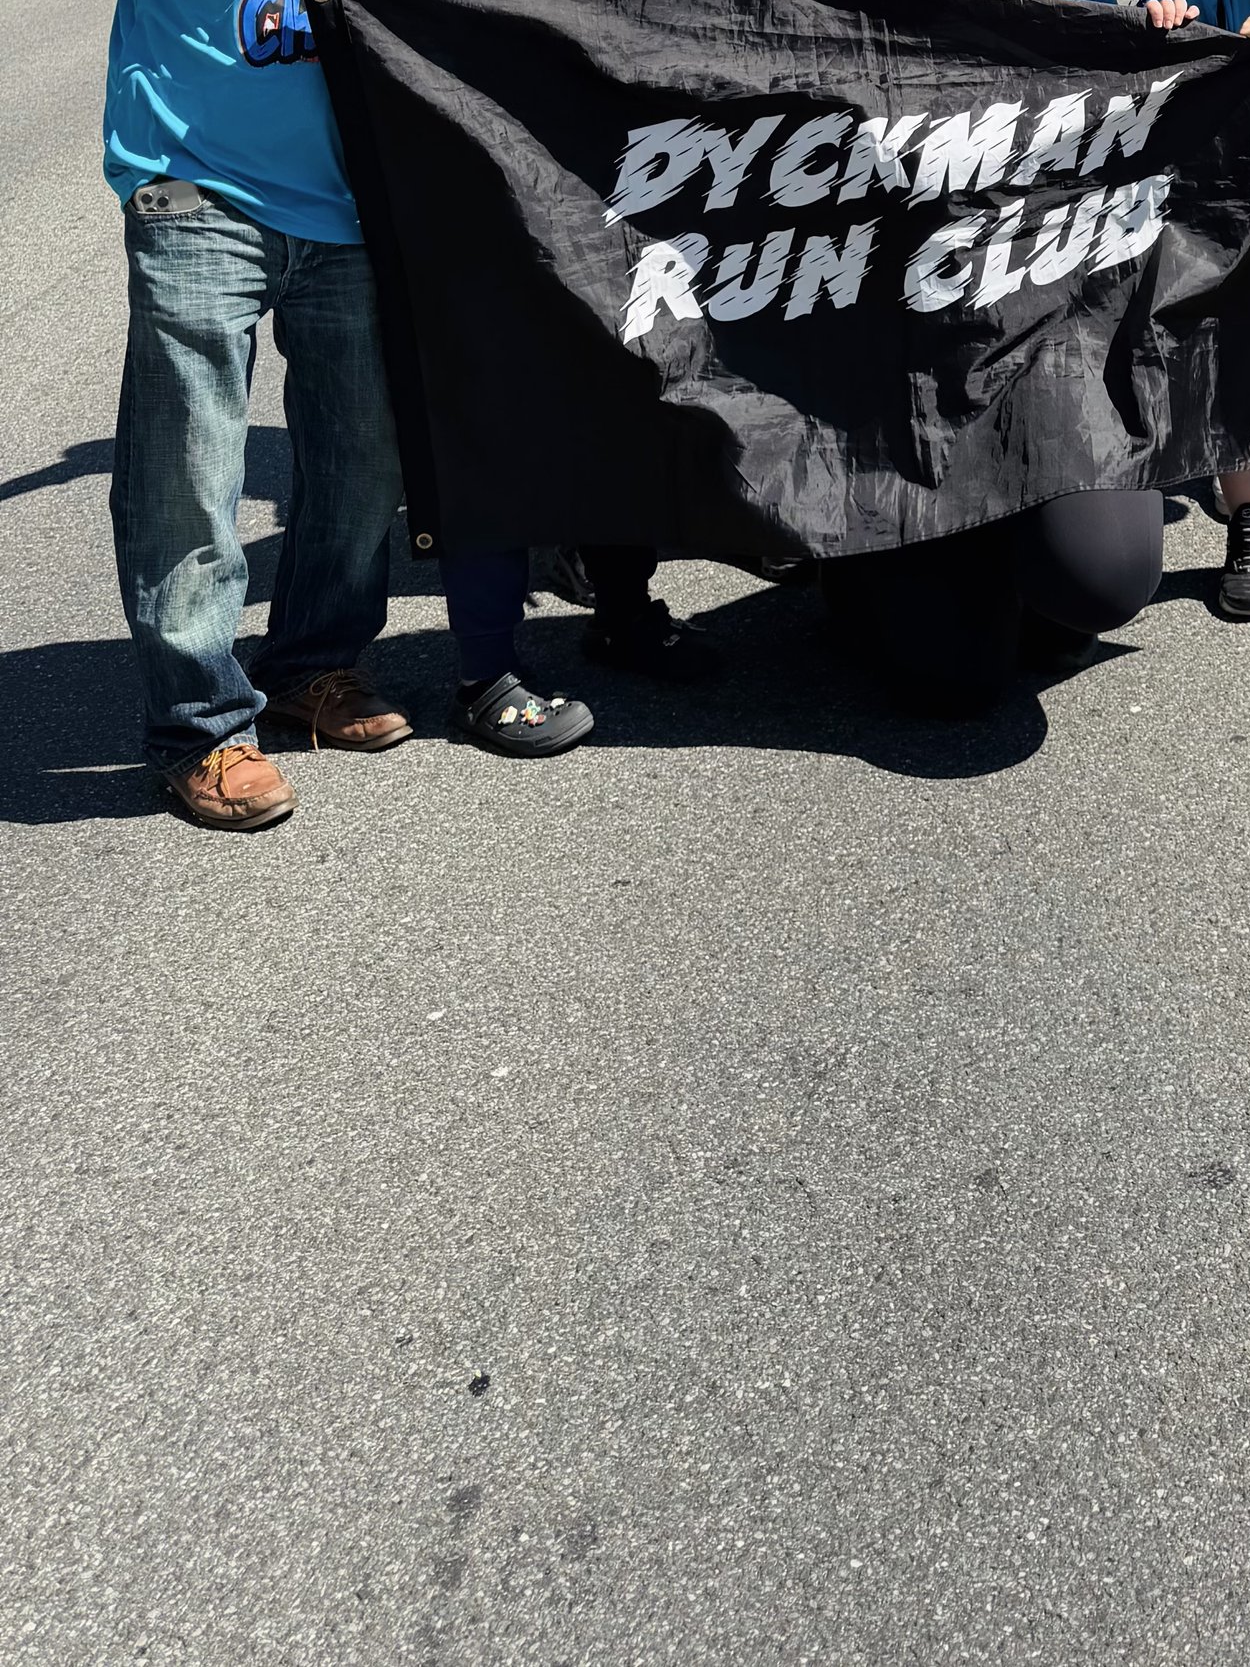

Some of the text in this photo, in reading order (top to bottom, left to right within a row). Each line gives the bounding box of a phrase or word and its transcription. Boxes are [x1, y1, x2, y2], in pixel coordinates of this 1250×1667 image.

[602, 71, 1184, 228] DYCKMAN
[619, 174, 1175, 346] RUN CLUB
